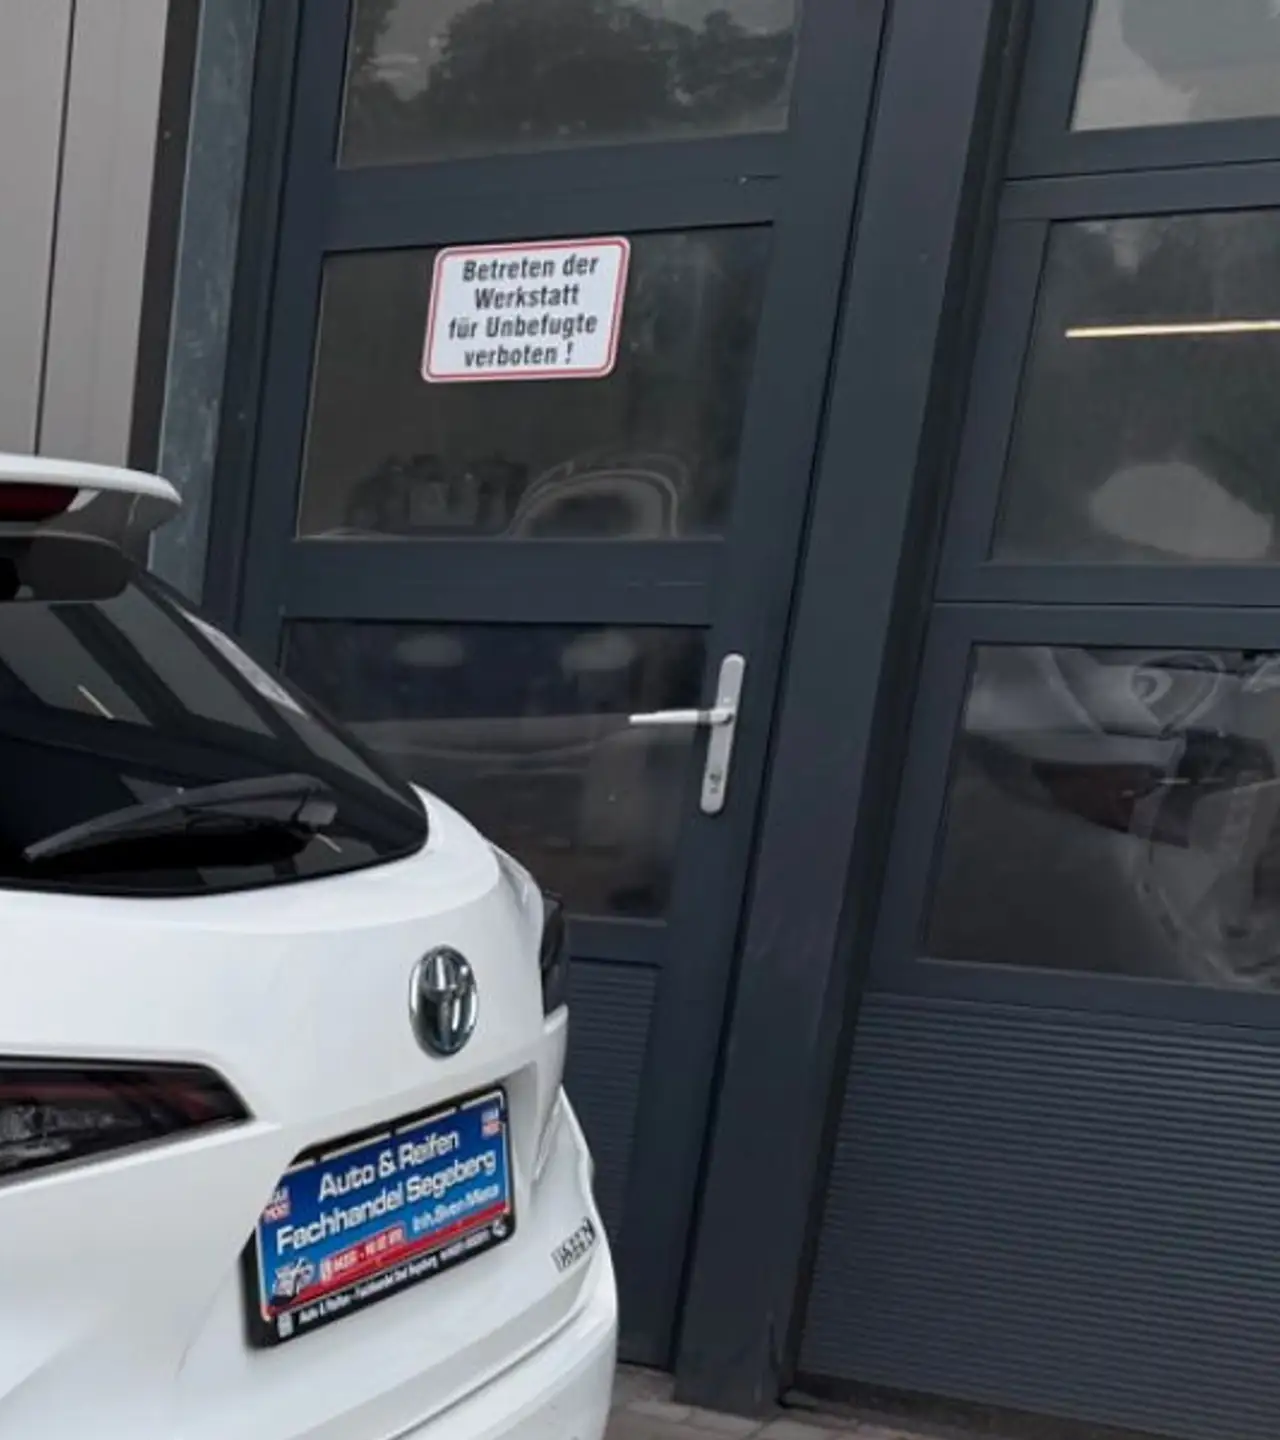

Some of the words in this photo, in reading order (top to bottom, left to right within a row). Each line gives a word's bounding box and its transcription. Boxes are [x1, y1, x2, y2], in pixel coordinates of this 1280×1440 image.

[462, 257, 555, 282] Betreten
[562, 253, 599, 276] der
[474, 284, 580, 310] Werkstatt
[449, 317, 478, 340] für
[485, 313, 598, 340] Unbefugte
[464, 344, 558, 368] verboten
[565, 341, 574, 365] !
[318, 1163, 376, 1202] Auto
[378, 1149, 397, 1178] &
[398, 1131, 459, 1170] Reifen
[277, 1181, 404, 1255] Fachhandel
[406, 1149, 496, 1203] Segeberg
